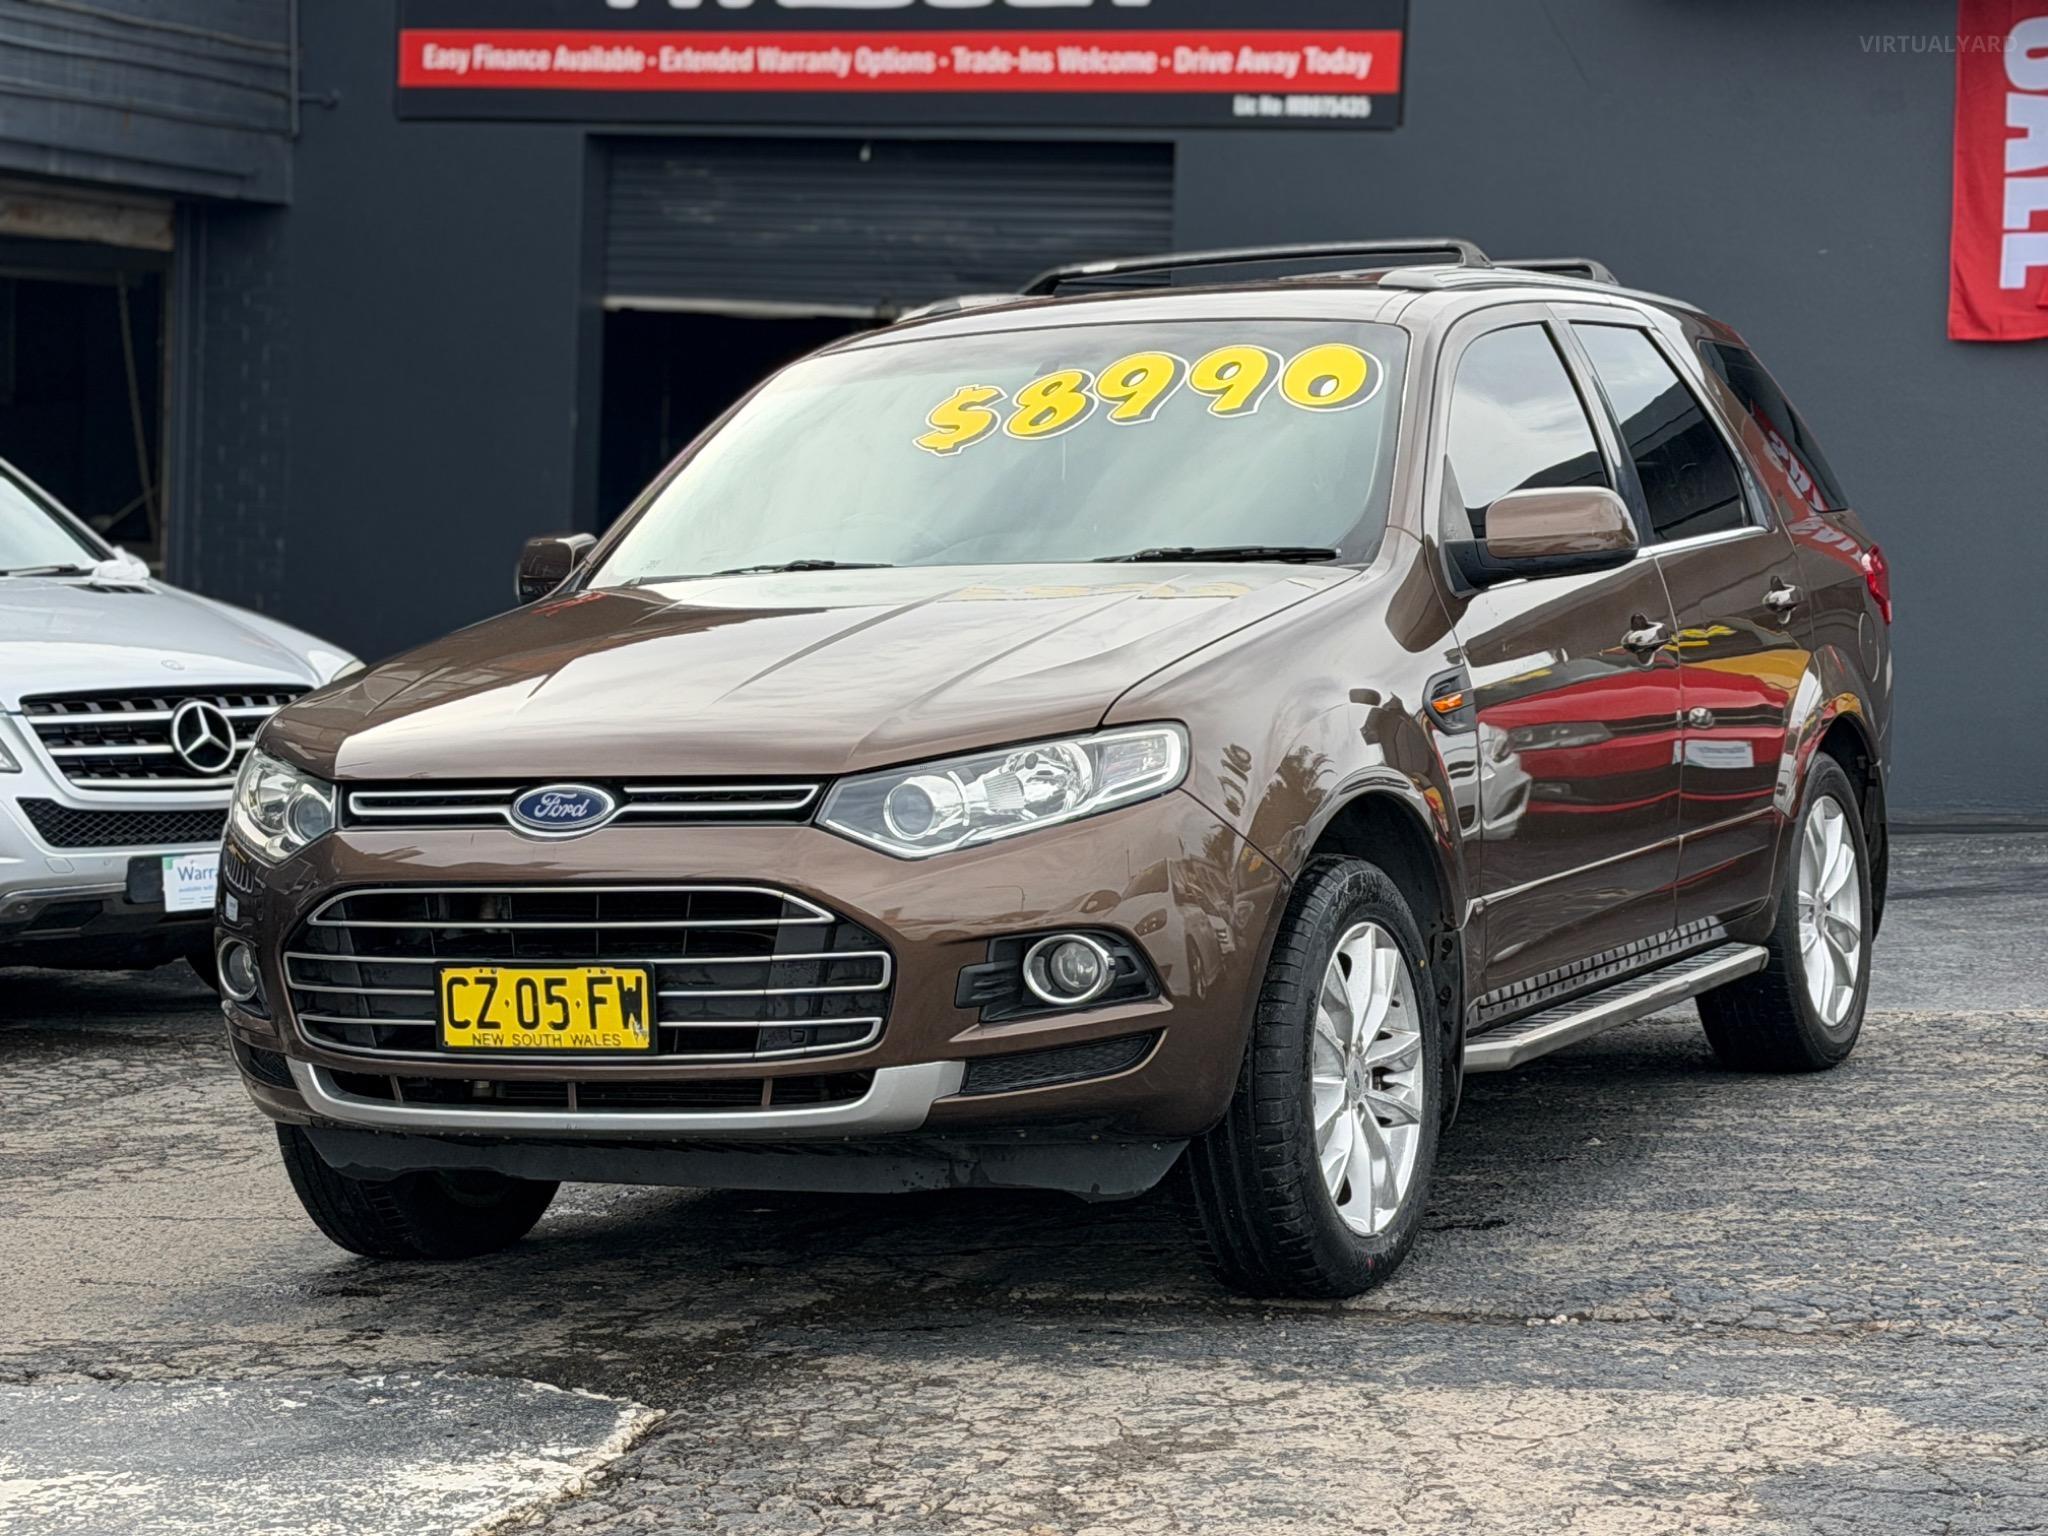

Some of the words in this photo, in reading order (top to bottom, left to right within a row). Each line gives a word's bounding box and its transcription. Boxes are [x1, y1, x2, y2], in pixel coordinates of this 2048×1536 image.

[422, 43, 471, 74] Easy
[472, 43, 551, 72] Finance
[553, 44, 645, 73] Available
[658, 45, 754, 73] Extended
[756, 46, 853, 78] Warranty
[854, 45, 937, 77] Options
[951, 45, 1054, 73] Trade-Ins
[1056, 45, 1158, 74] Welcome
[1172, 45, 1234, 74] Drive
[1235, 45, 1301, 79] Away
[1303, 45, 1373, 80] Today
[912, 343, 1384, 456] $8990
[534, 792, 590, 818] Ford
[177, 865, 217, 882] Warr
[472, 1034, 504, 1047] NEW
[512, 1034, 563, 1047] SOUTH
[570, 1034, 622, 1047] WALES
